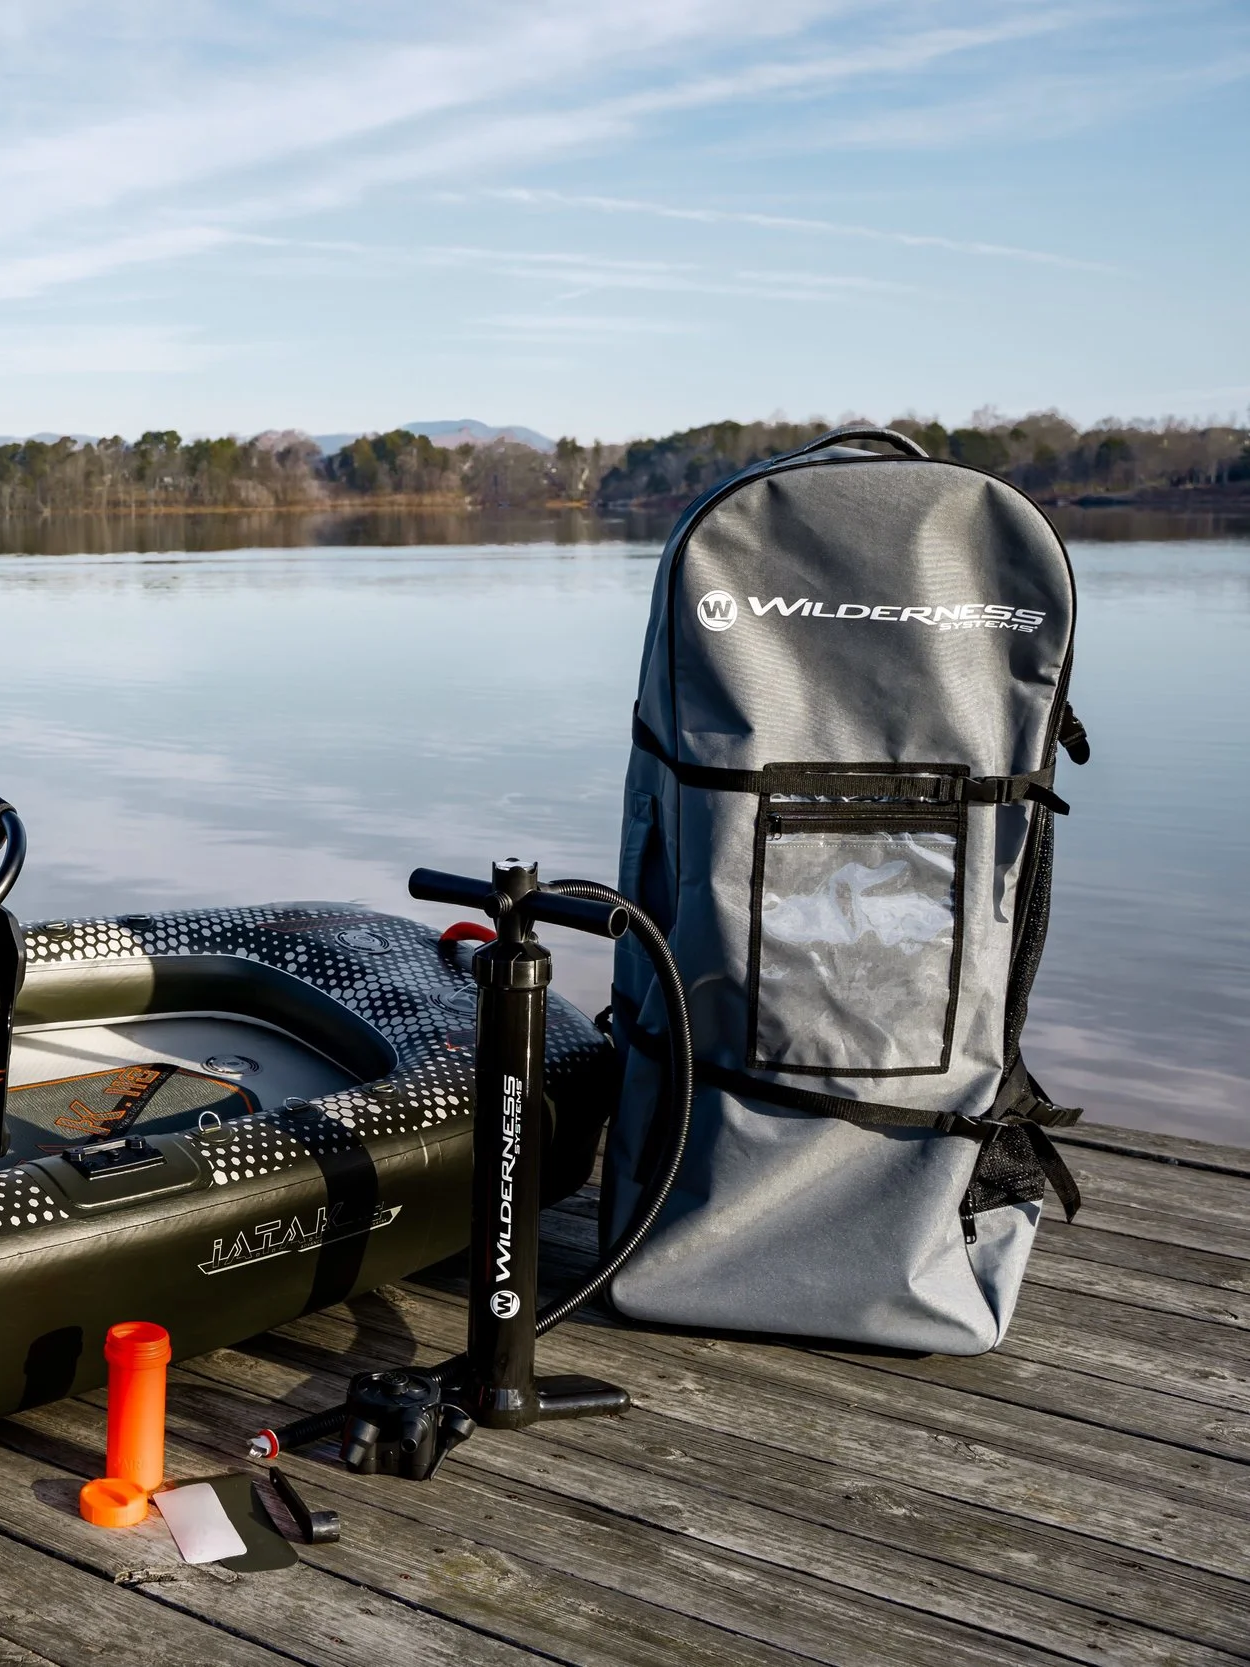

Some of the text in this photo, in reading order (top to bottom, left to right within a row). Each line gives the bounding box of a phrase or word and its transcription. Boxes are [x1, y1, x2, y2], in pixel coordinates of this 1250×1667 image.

[747, 596, 1047, 626] WILDERNESS
[938, 621, 1038, 634] SYSTEMS
[514, 1077, 523, 1155] SYSTEMS
[495, 1074, 516, 1283] WILDERNESS
